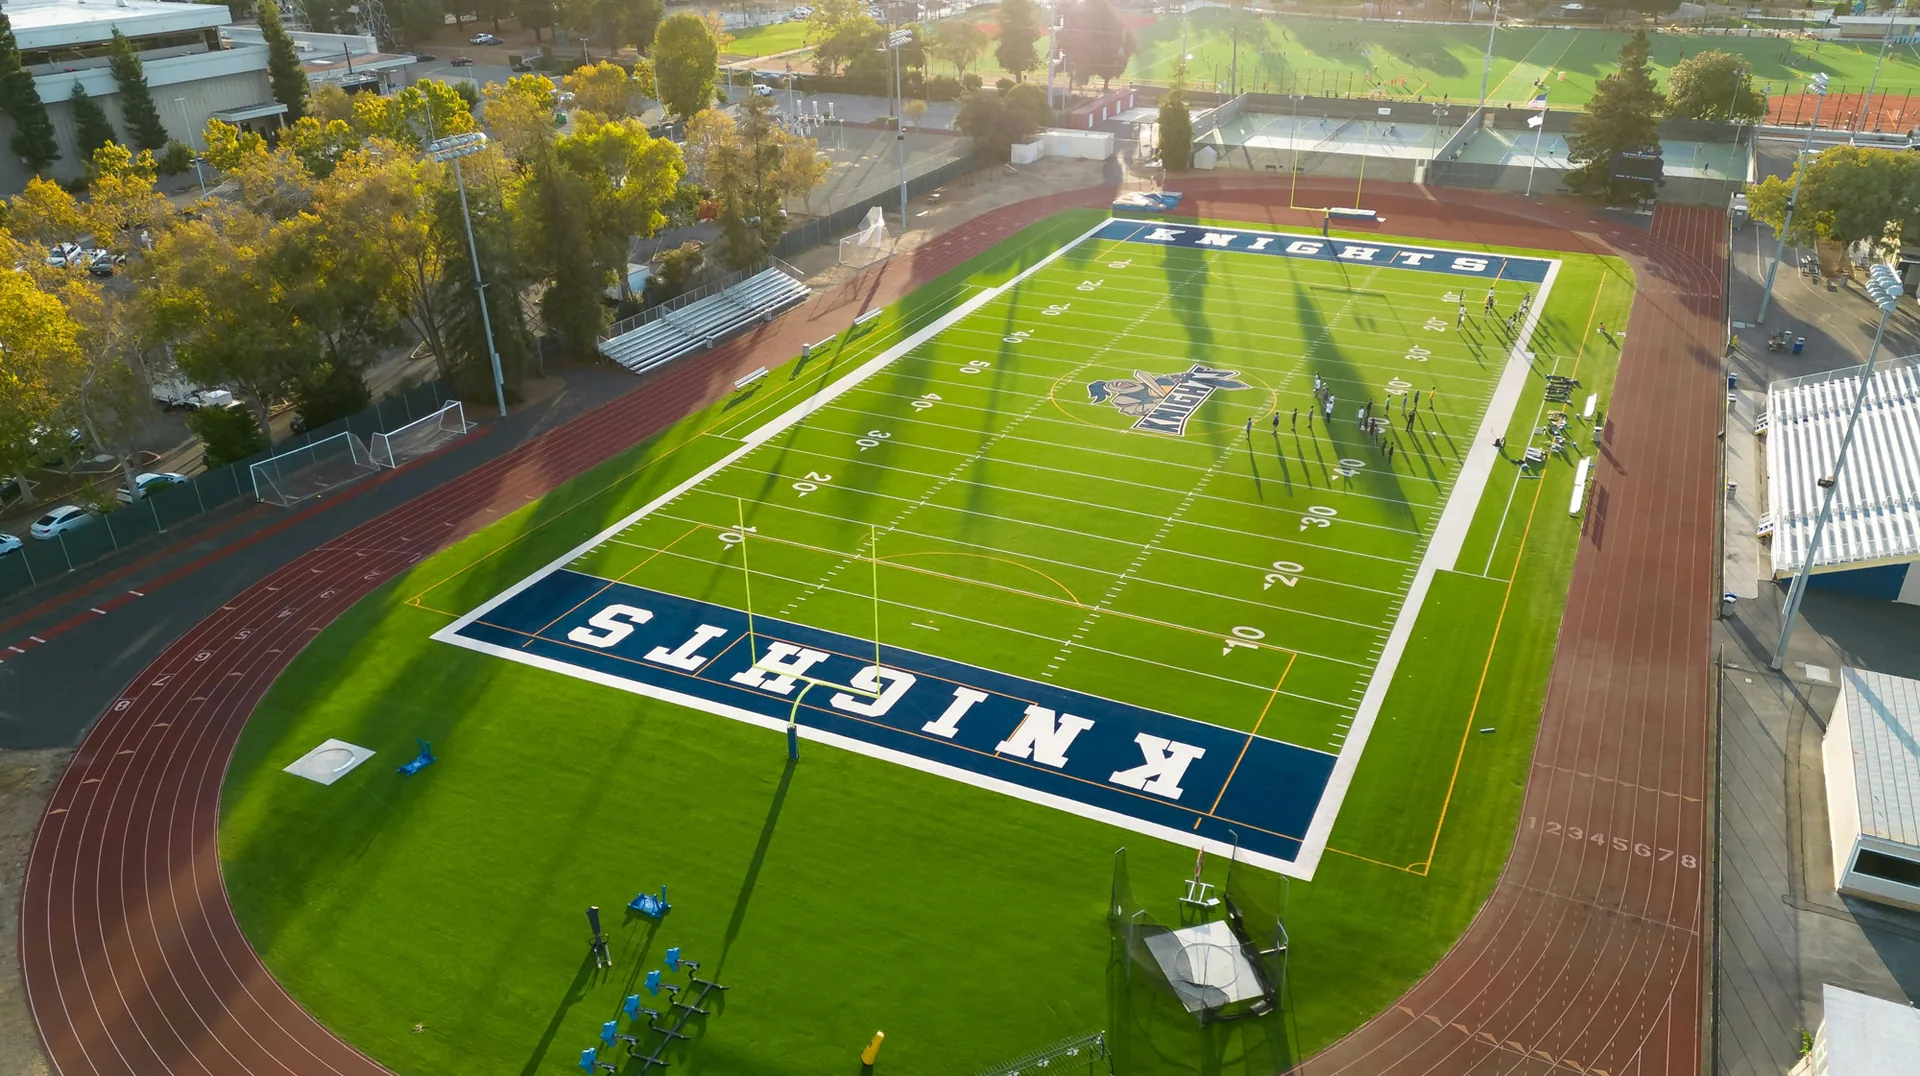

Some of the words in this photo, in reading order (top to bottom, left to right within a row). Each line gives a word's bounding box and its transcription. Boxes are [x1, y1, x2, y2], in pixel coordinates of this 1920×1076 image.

[1145, 228, 1489, 272] KNIGHTS
[1423, 319, 1449, 332] 20
[1003, 331, 1031, 343] 40
[1404, 347, 1431, 362] 30
[960, 359, 990, 375] 50
[1384, 380, 1413, 395] 40
[911, 392, 942, 409] 40
[855, 430, 891, 448] 30
[1333, 458, 1366, 477] 40
[792, 471, 832, 493] 20
[1301, 506, 1337, 528] 30
[718, 525, 757, 543] 10
[364, 571, 380, 580] 2
[1265, 561, 1304, 587] 20
[320, 590, 335, 599] 3
[277, 609, 292, 619] 4
[234, 630, 251, 640] 5
[1224, 626, 1265, 649] 10
[194, 652, 211, 662] 6
[152, 675, 172, 686] 7
[113, 699, 130, 711] 8
[566, 604, 1205, 800] KNIGHTS
[1546, 821, 1562, 835] 2
[1567, 826, 1583, 840] 3
[1590, 833, 1605, 846] 4
[1612, 837, 1628, 852] 5
[1634, 843, 1651, 857] 6
[1658, 848, 1674, 862] 7
[1681, 854, 1697, 868] 8
